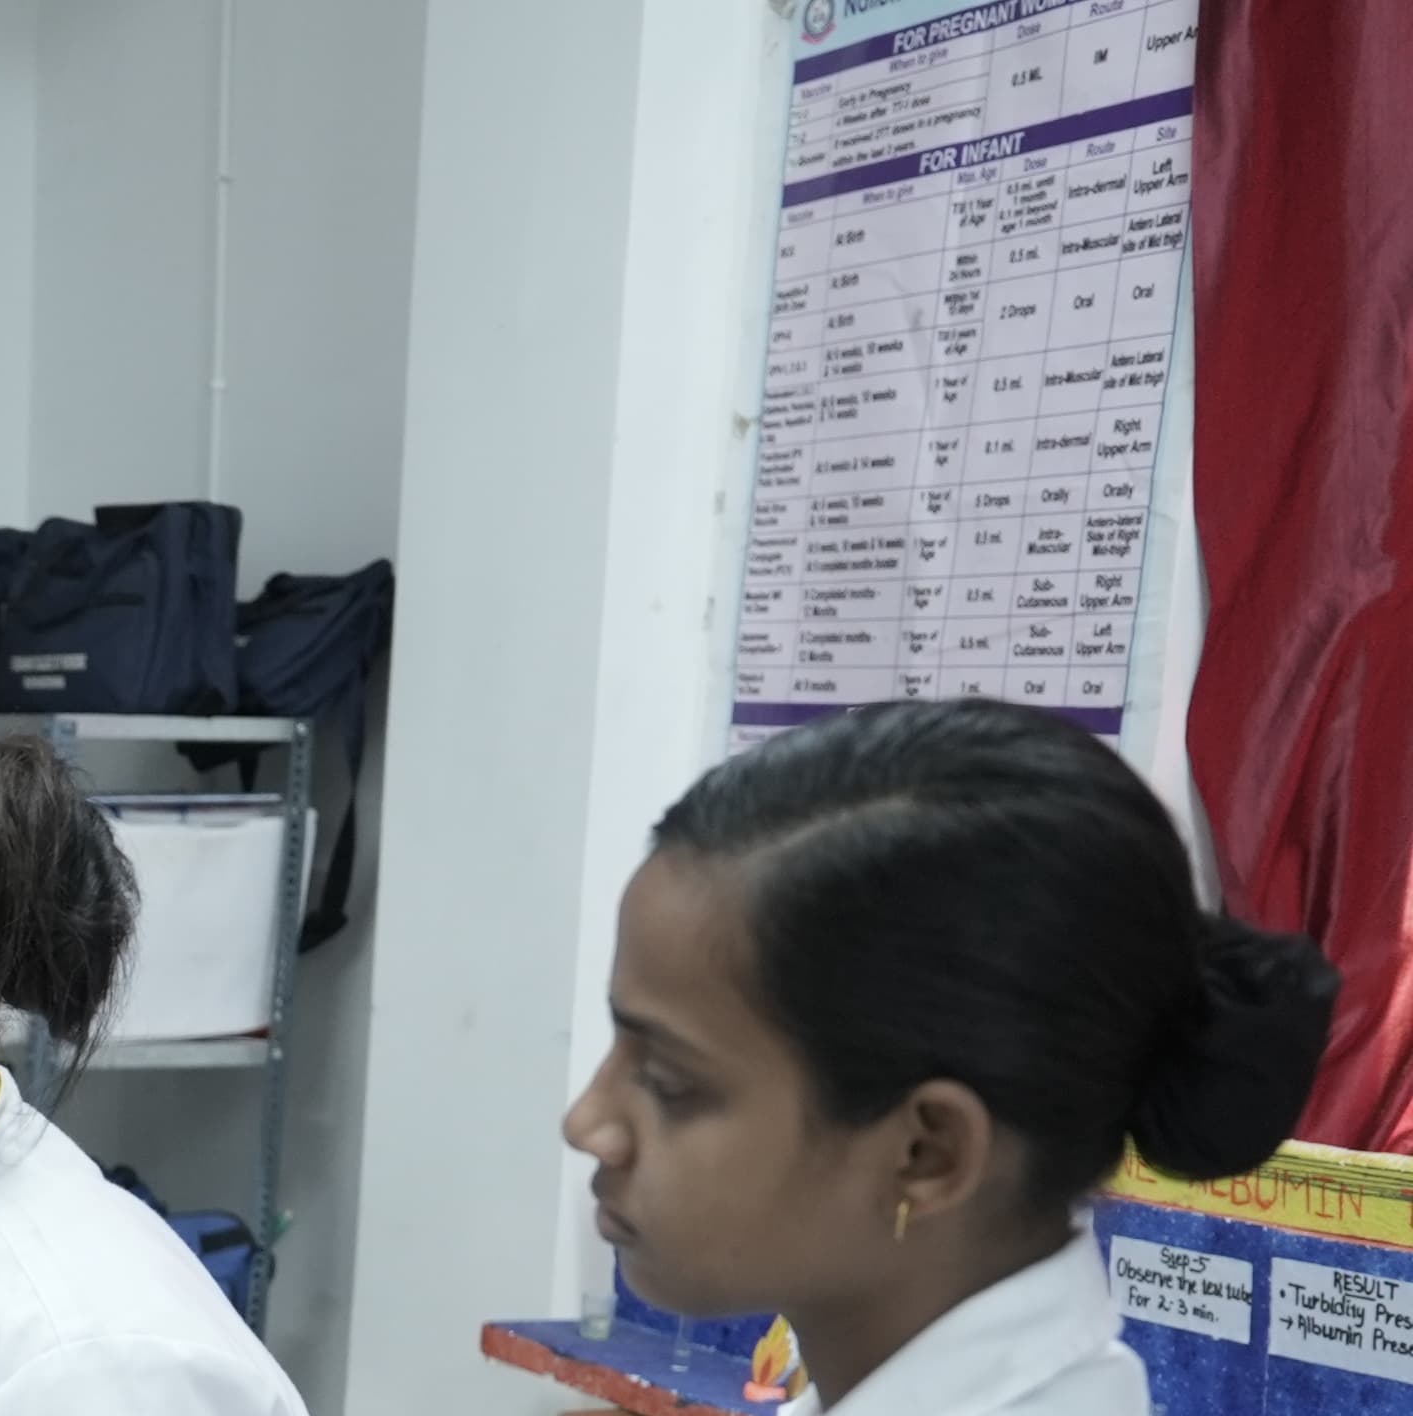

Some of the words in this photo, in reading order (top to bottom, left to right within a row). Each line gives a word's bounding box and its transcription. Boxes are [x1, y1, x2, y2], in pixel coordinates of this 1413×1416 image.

[893, 27, 926, 54] FOR
[928, 3, 1020, 44] PREGNANT
[1146, 30, 1183, 52] Upper
[919, 150, 957, 173] FOR
[961, 131, 1026, 168] INFANT
[1152, 157, 1173, 176] Left
[1133, 178, 1164, 195] Upper
[1166, 172, 1189, 186] Arm
[1132, 283, 1155, 300] Oral
[1073, 293, 1095, 310] Oral
[1114, 418, 1142, 436] Right
[1097, 441, 1128, 459] Upper
[1130, 439, 1152, 454] Arm
[1041, 488, 1069, 504] Orally
[1103, 483, 1134, 500] Orally
[1095, 574, 1122, 591] Right
[1080, 596, 1109, 610] Upper
[1093, 623, 1112, 637] Left
[1076, 642, 1103, 658] Upper
[1024, 681, 1045, 695] Oral
[1082, 682, 1103, 695] Oral
[1116, 1256, 1175, 1289] Observe
[1333, 1270, 1400, 1300] RESULT
[1288, 1282, 1365, 1328] Turbidity
[1298, 1314, 1363, 1349] Albumin
